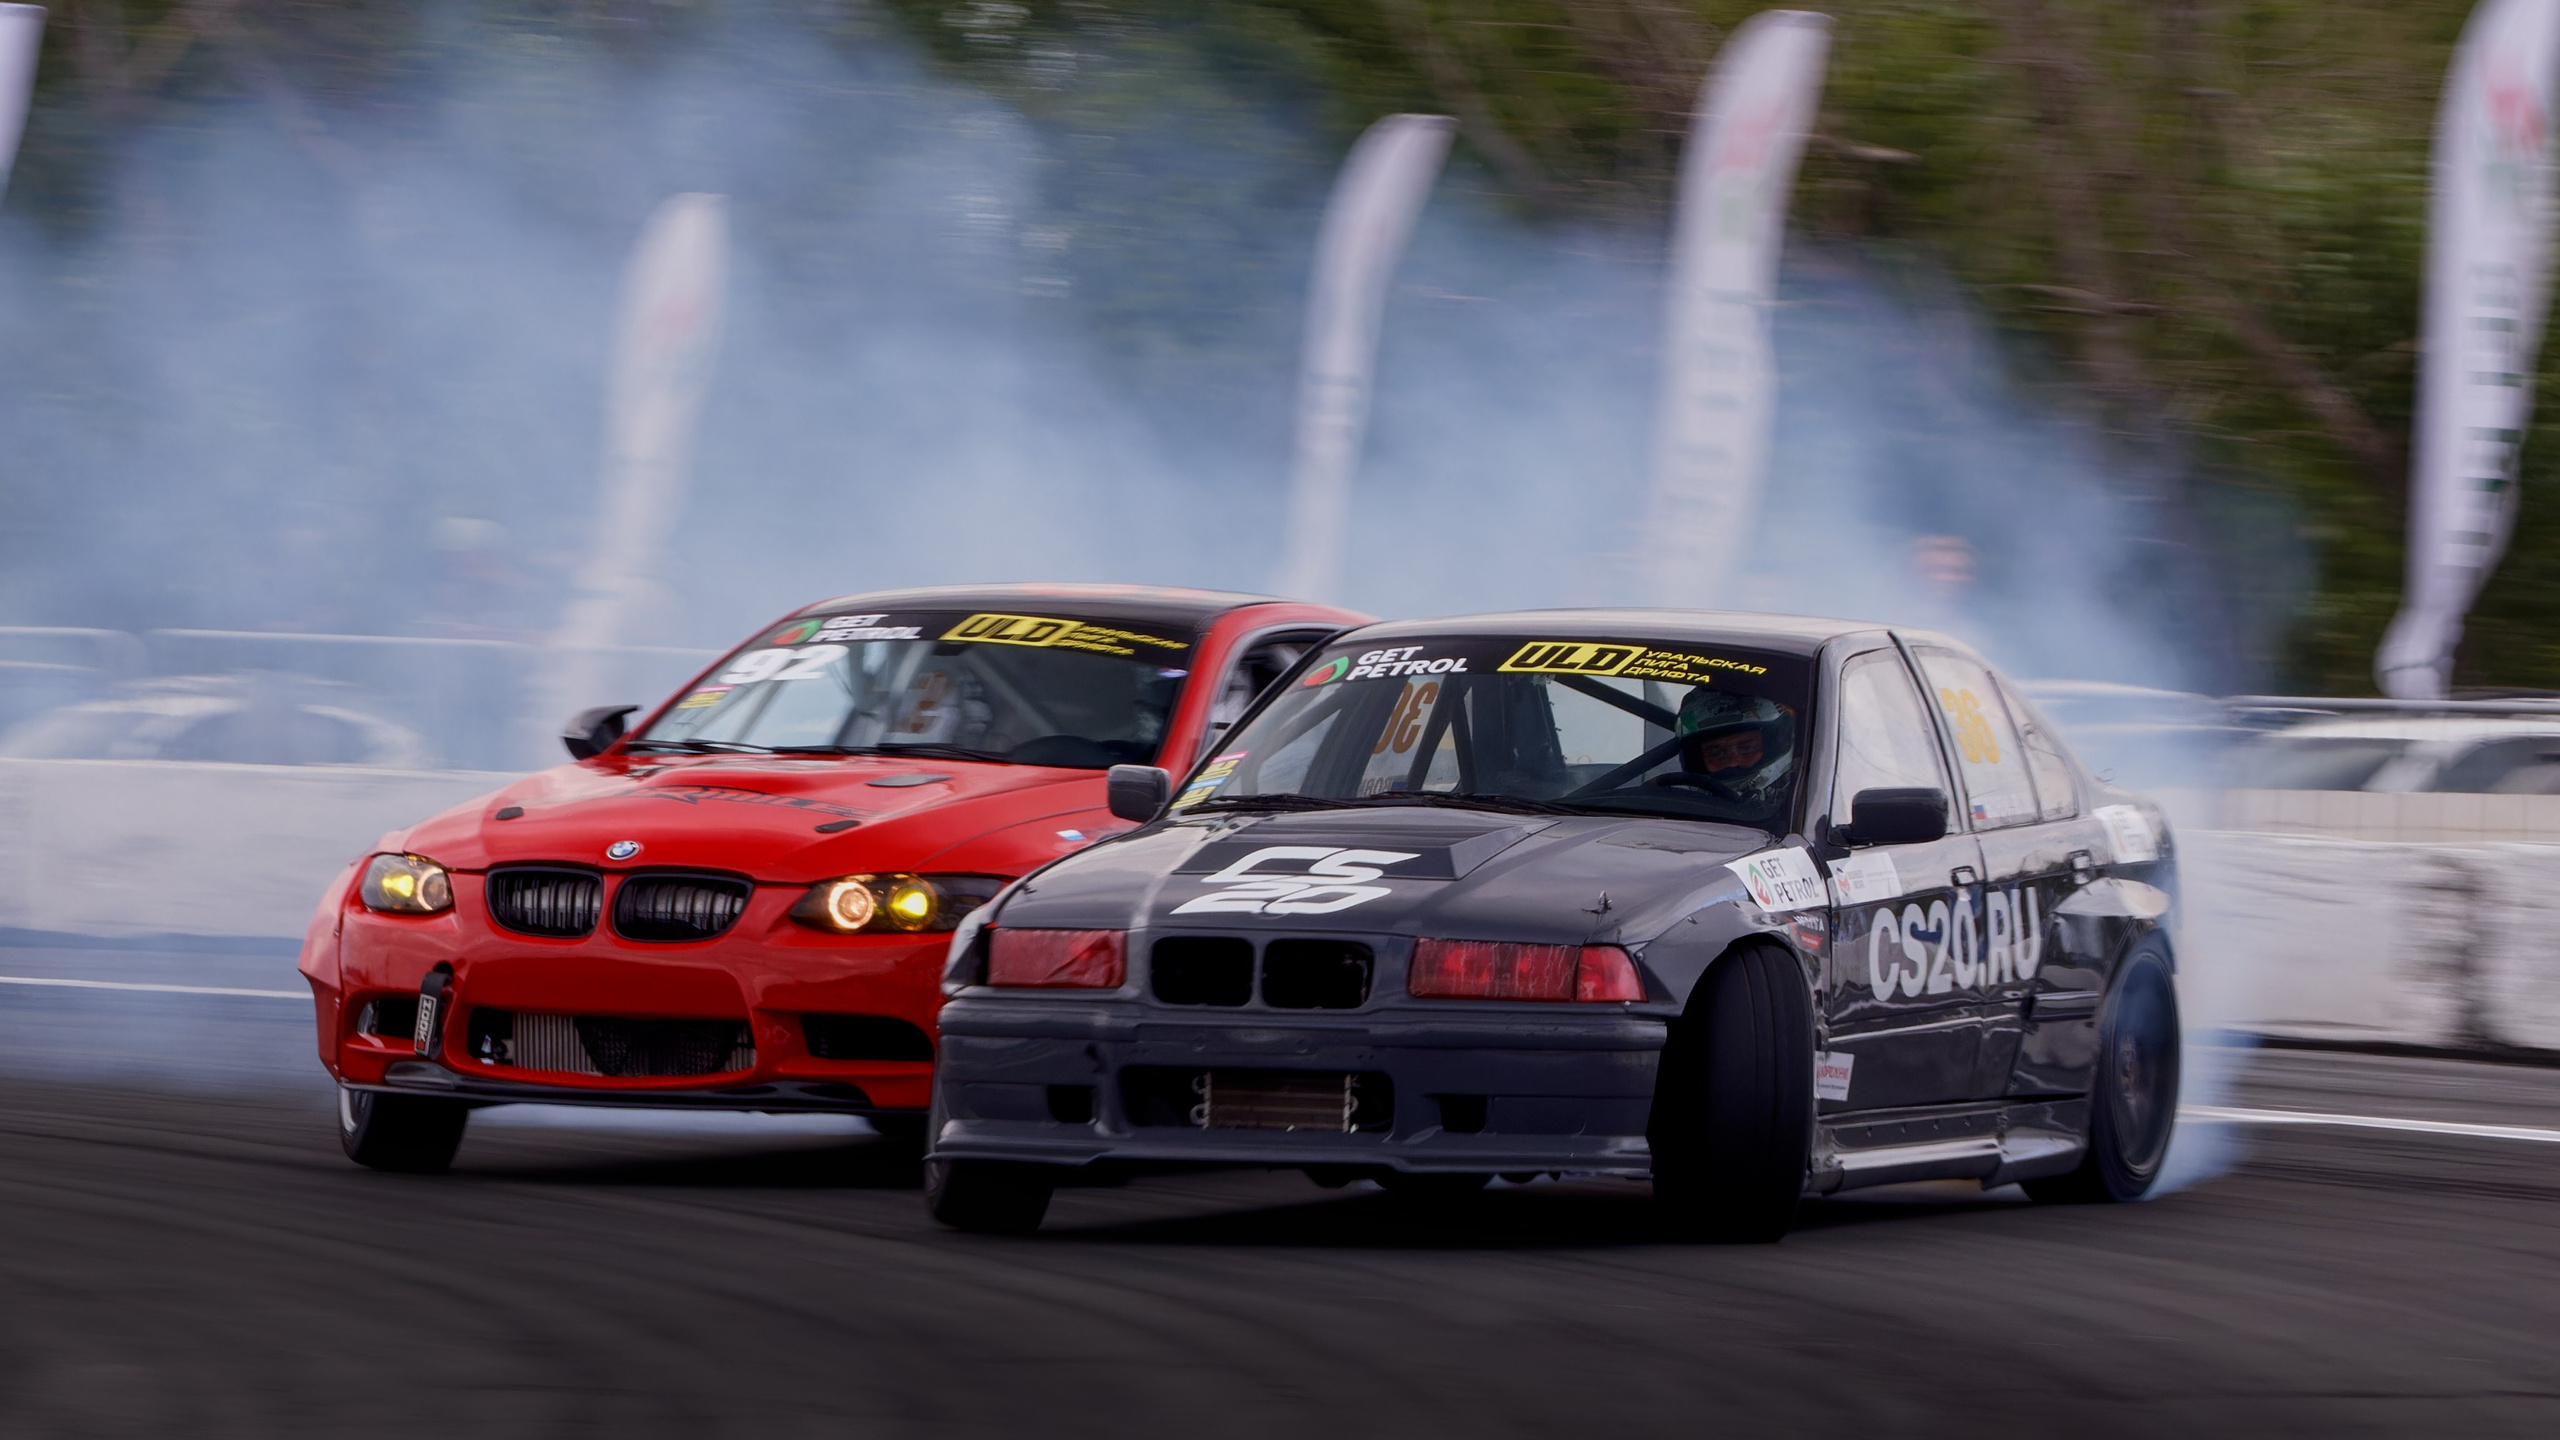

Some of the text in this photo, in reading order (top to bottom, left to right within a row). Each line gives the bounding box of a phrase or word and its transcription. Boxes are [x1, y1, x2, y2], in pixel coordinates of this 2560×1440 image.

[957, 617, 1065, 642] ULD
[719, 644, 849, 684] 92
[1357, 645, 1424, 665] GET
[1509, 644, 1634, 670] ULD
[1634, 657, 1689, 671] ЛИГА
[1646, 650, 1767, 675] УРАЛЬСКАЯ
[1346, 658, 1468, 681] PETROL
[1622, 666, 1711, 683] ДРИФТА
[1201, 846, 1422, 885] CS
[1760, 857, 1787, 879] GET
[1169, 881, 1392, 915] 20
[1773, 876, 1820, 904] PETROL
[1869, 886, 2042, 1002] CS20.RU
